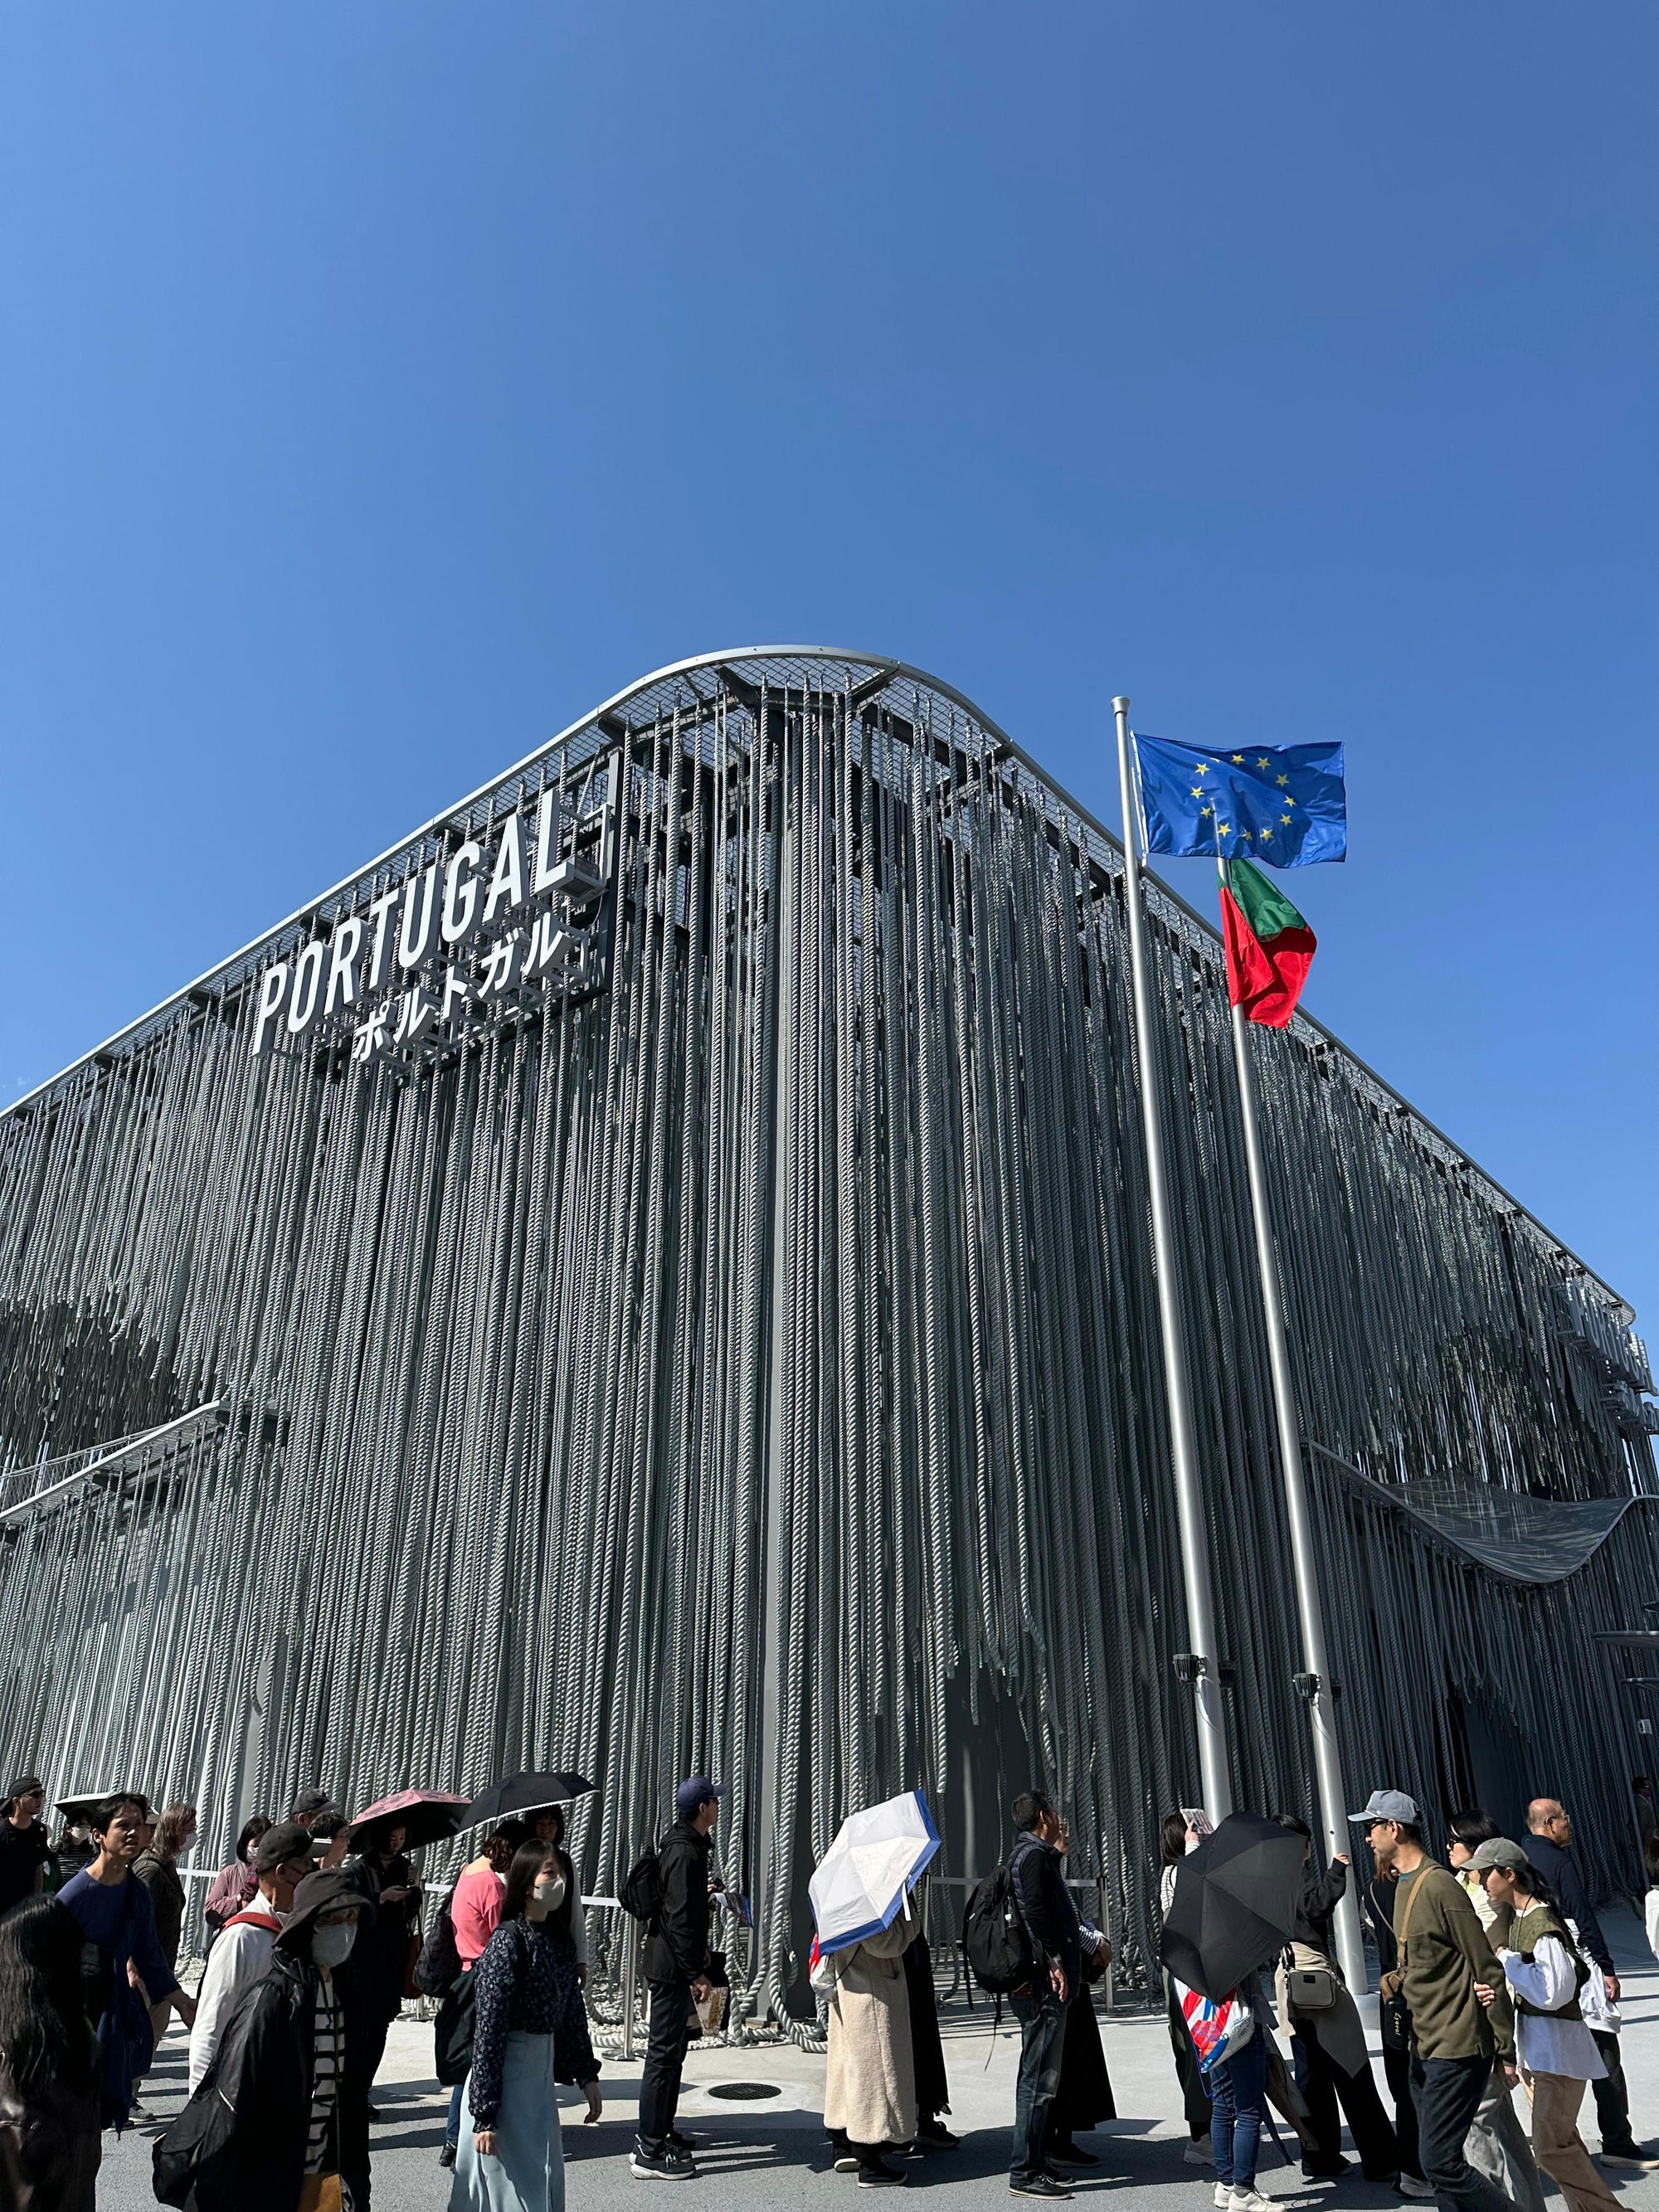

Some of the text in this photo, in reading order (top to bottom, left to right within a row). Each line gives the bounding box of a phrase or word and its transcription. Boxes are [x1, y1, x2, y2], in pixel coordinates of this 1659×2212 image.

[251, 788, 572, 1057] PORTUGAL
[352, 912, 572, 1064] ポルトガル
